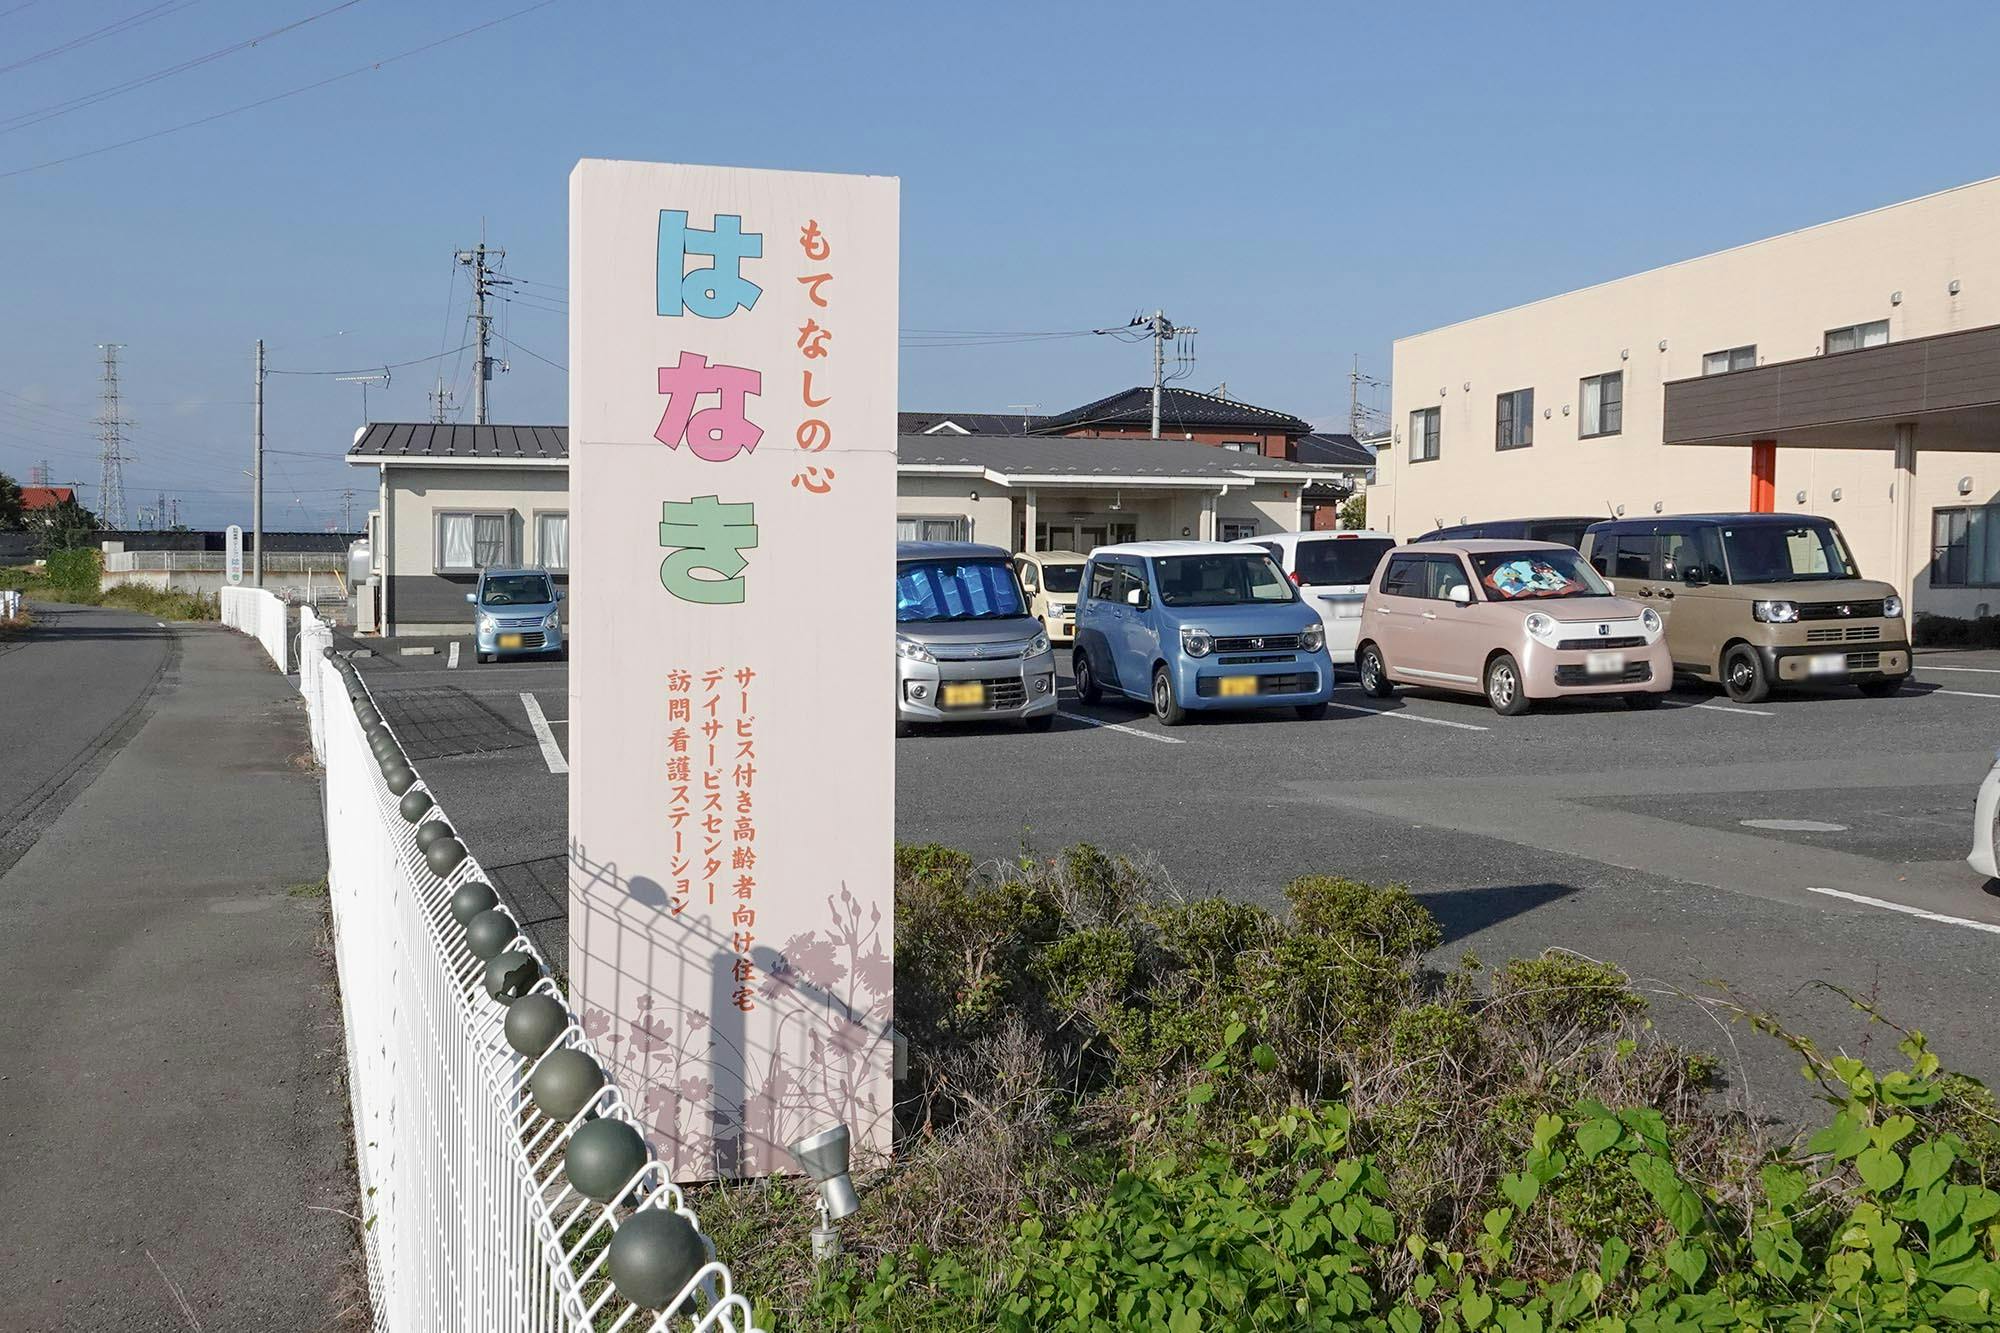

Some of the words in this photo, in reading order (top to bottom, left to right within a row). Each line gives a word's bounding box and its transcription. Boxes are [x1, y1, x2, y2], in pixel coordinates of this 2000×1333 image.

[654, 208, 765, 605] はなき
[790, 218, 836, 495] もてなしの心
[666, 669, 692, 916] 訪問看護ステーション
[700, 665, 725, 905] デイサービスセンター
[731, 666, 758, 1013] サービス付き高齢者向け住宅
